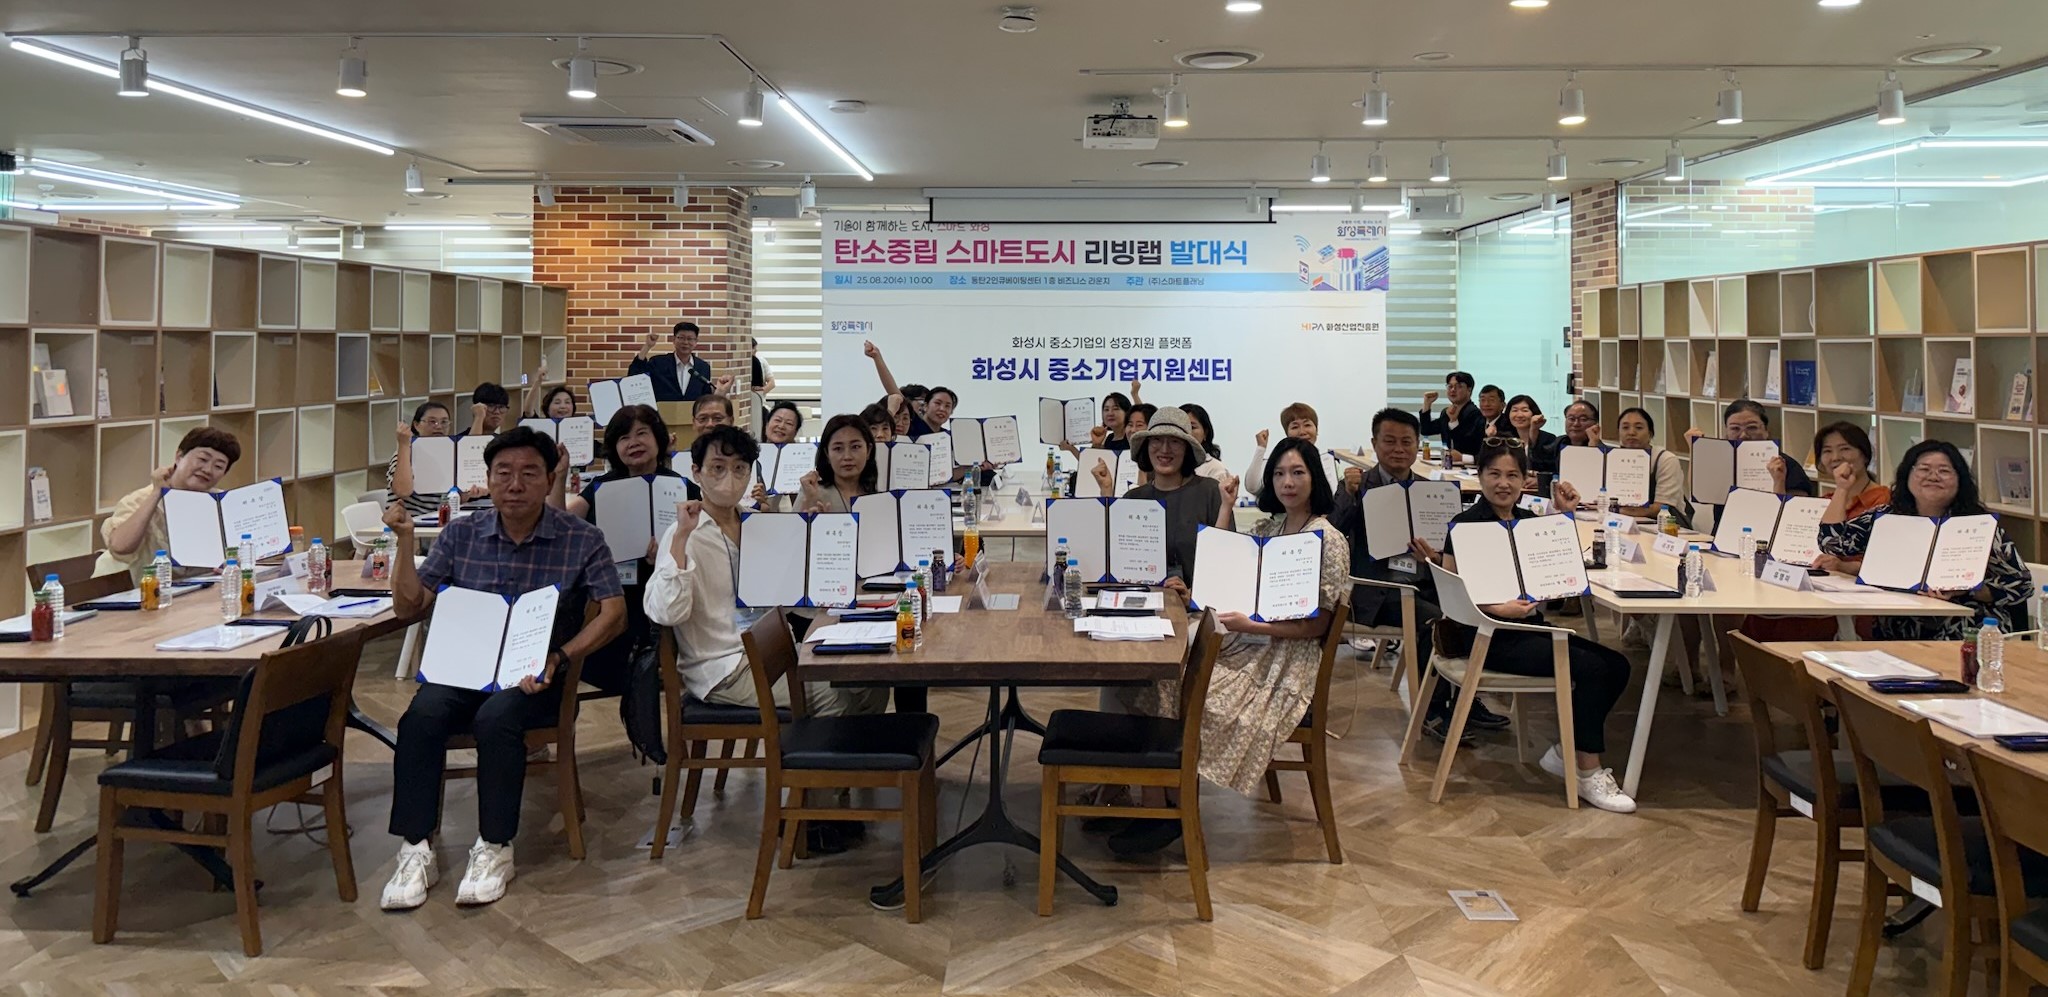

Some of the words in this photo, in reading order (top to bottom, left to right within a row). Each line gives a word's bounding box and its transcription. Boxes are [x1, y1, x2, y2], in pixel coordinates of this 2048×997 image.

[866, 220, 908, 232] 함께하는
[834, 239, 938, 264] 탄소중립
[946, 239, 1076, 265] 스마트도시
[1085, 240, 1162, 265] 리빙랩
[1170, 240, 1248, 265] 발대식
[834, 275, 853, 285] 일시
[909, 276, 933, 285] 10:00
[949, 275, 967, 285] 장소
[971, 276, 1042, 286] 동탄2인큐베이팅센터
[1057, 276, 1087, 286] 비즈니스
[1088, 276, 1111, 286] 라운지
[1126, 276, 1144, 286] 주관
[1326, 322, 1379, 332] 화성산업진흥원
[1012, 336, 1046, 349] 화성시
[1049, 336, 1106, 349] 중소기업의
[1109, 336, 1155, 349] 성장지원
[1158, 336, 1193, 350] 플랫폼
[971, 357, 1040, 381] 화성시
[1048, 358, 1233, 382] 중소기업지원센터
